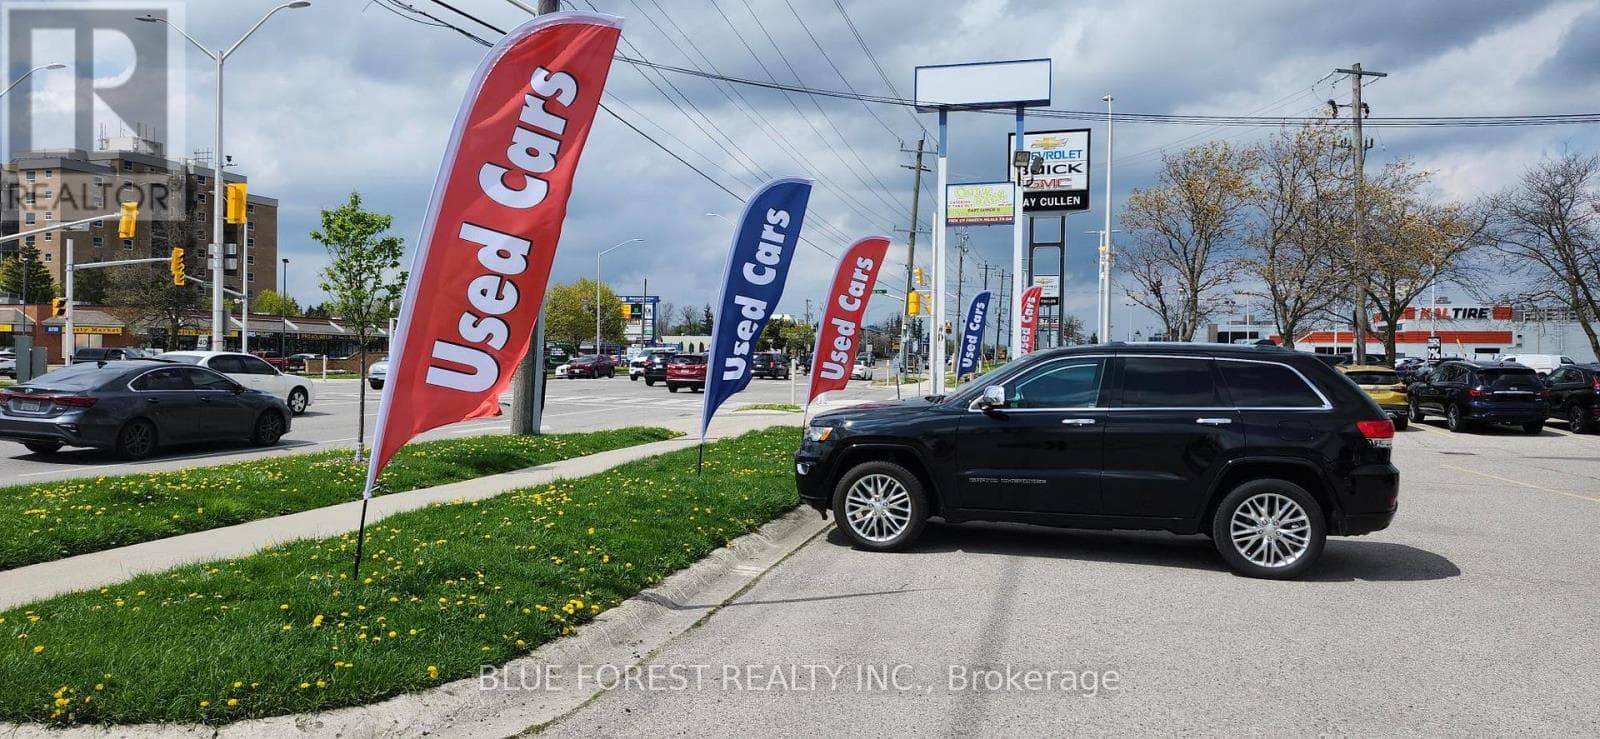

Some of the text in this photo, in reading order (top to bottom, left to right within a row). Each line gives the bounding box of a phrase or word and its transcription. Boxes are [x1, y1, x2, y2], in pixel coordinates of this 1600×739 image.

[1031, 150, 1083, 160] EVROLET
[425, 66, 579, 393] Used Cars
[1023, 198, 1036, 207] AY
[1040, 196, 1081, 207] CULLEN
[722, 208, 790, 381] Used Cars
[820, 256, 874, 380] Used Cars
[1021, 296, 1035, 354] sed Cars
[962, 302, 985, 368] Used Cars
